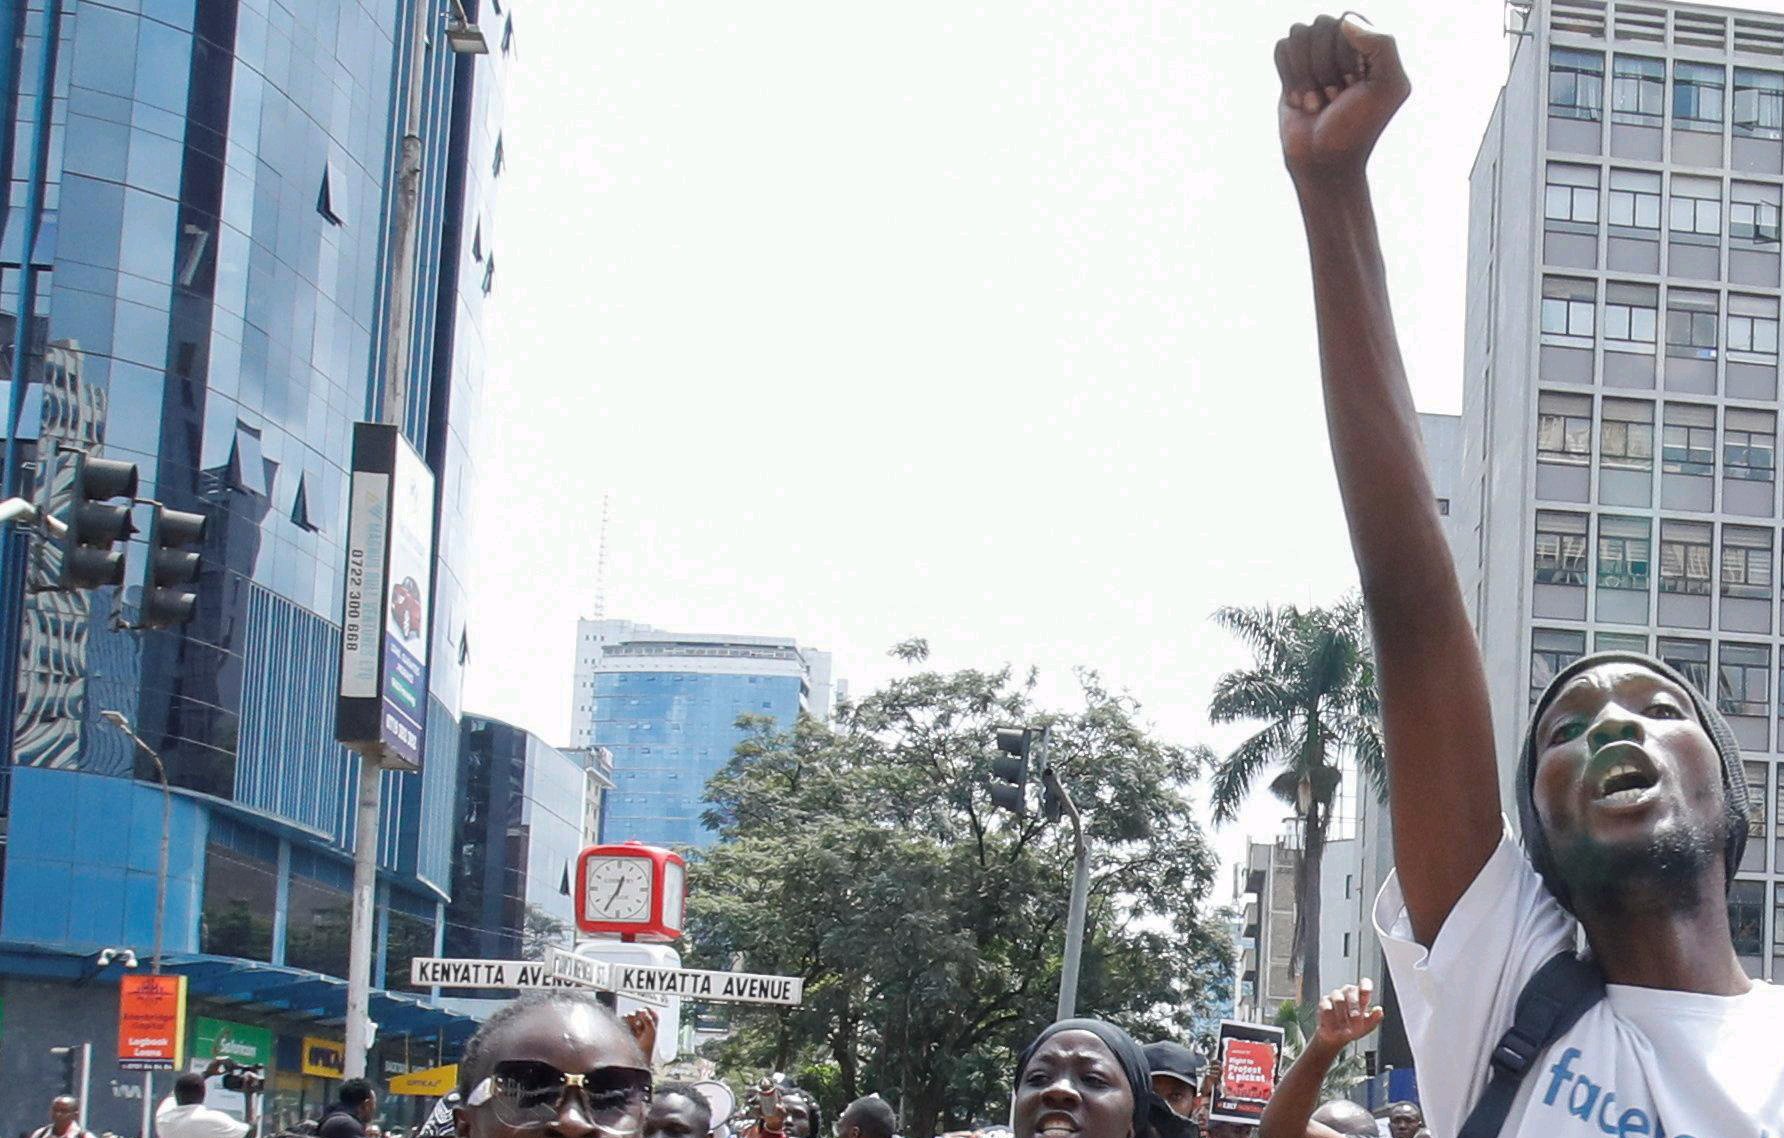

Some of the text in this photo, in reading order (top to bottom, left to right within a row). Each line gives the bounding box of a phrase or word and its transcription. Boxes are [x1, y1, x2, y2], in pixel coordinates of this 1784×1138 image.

[346, 549, 363, 652] 0722 300 668
[419, 961, 504, 984] KENYATTA
[623, 969, 792, 1000] KENYATTA AVENUE
